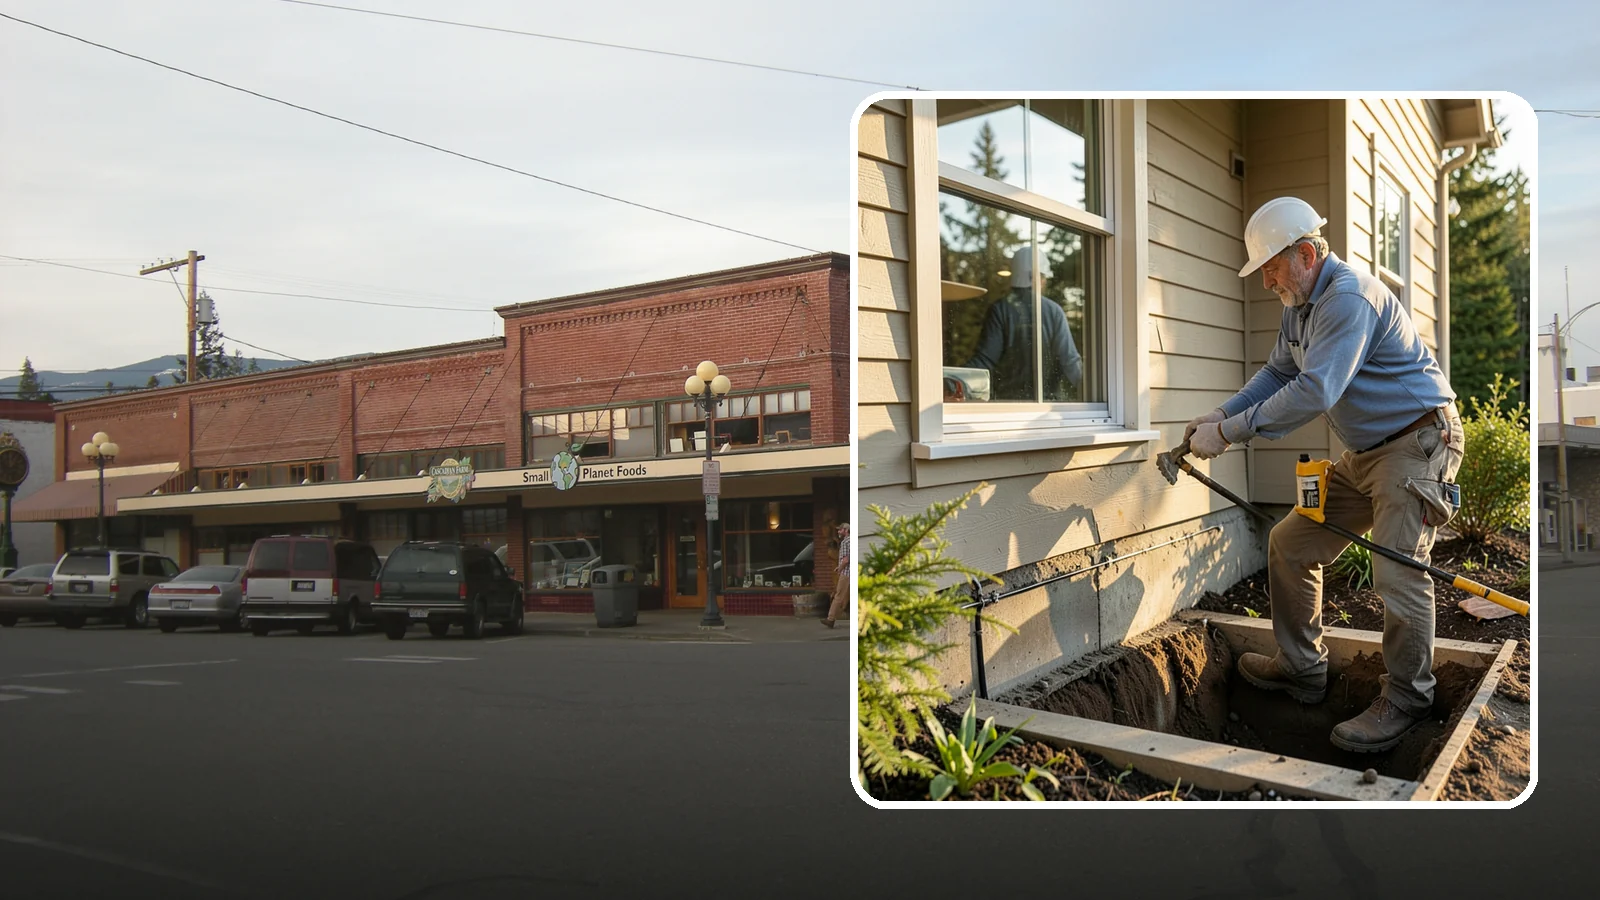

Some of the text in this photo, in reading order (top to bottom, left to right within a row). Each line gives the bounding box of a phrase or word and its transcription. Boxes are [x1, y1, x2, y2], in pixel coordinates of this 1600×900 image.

[431, 466, 469, 476] CASCADIAN FARM
[523, 464, 647, 483] Small Planet Foods
